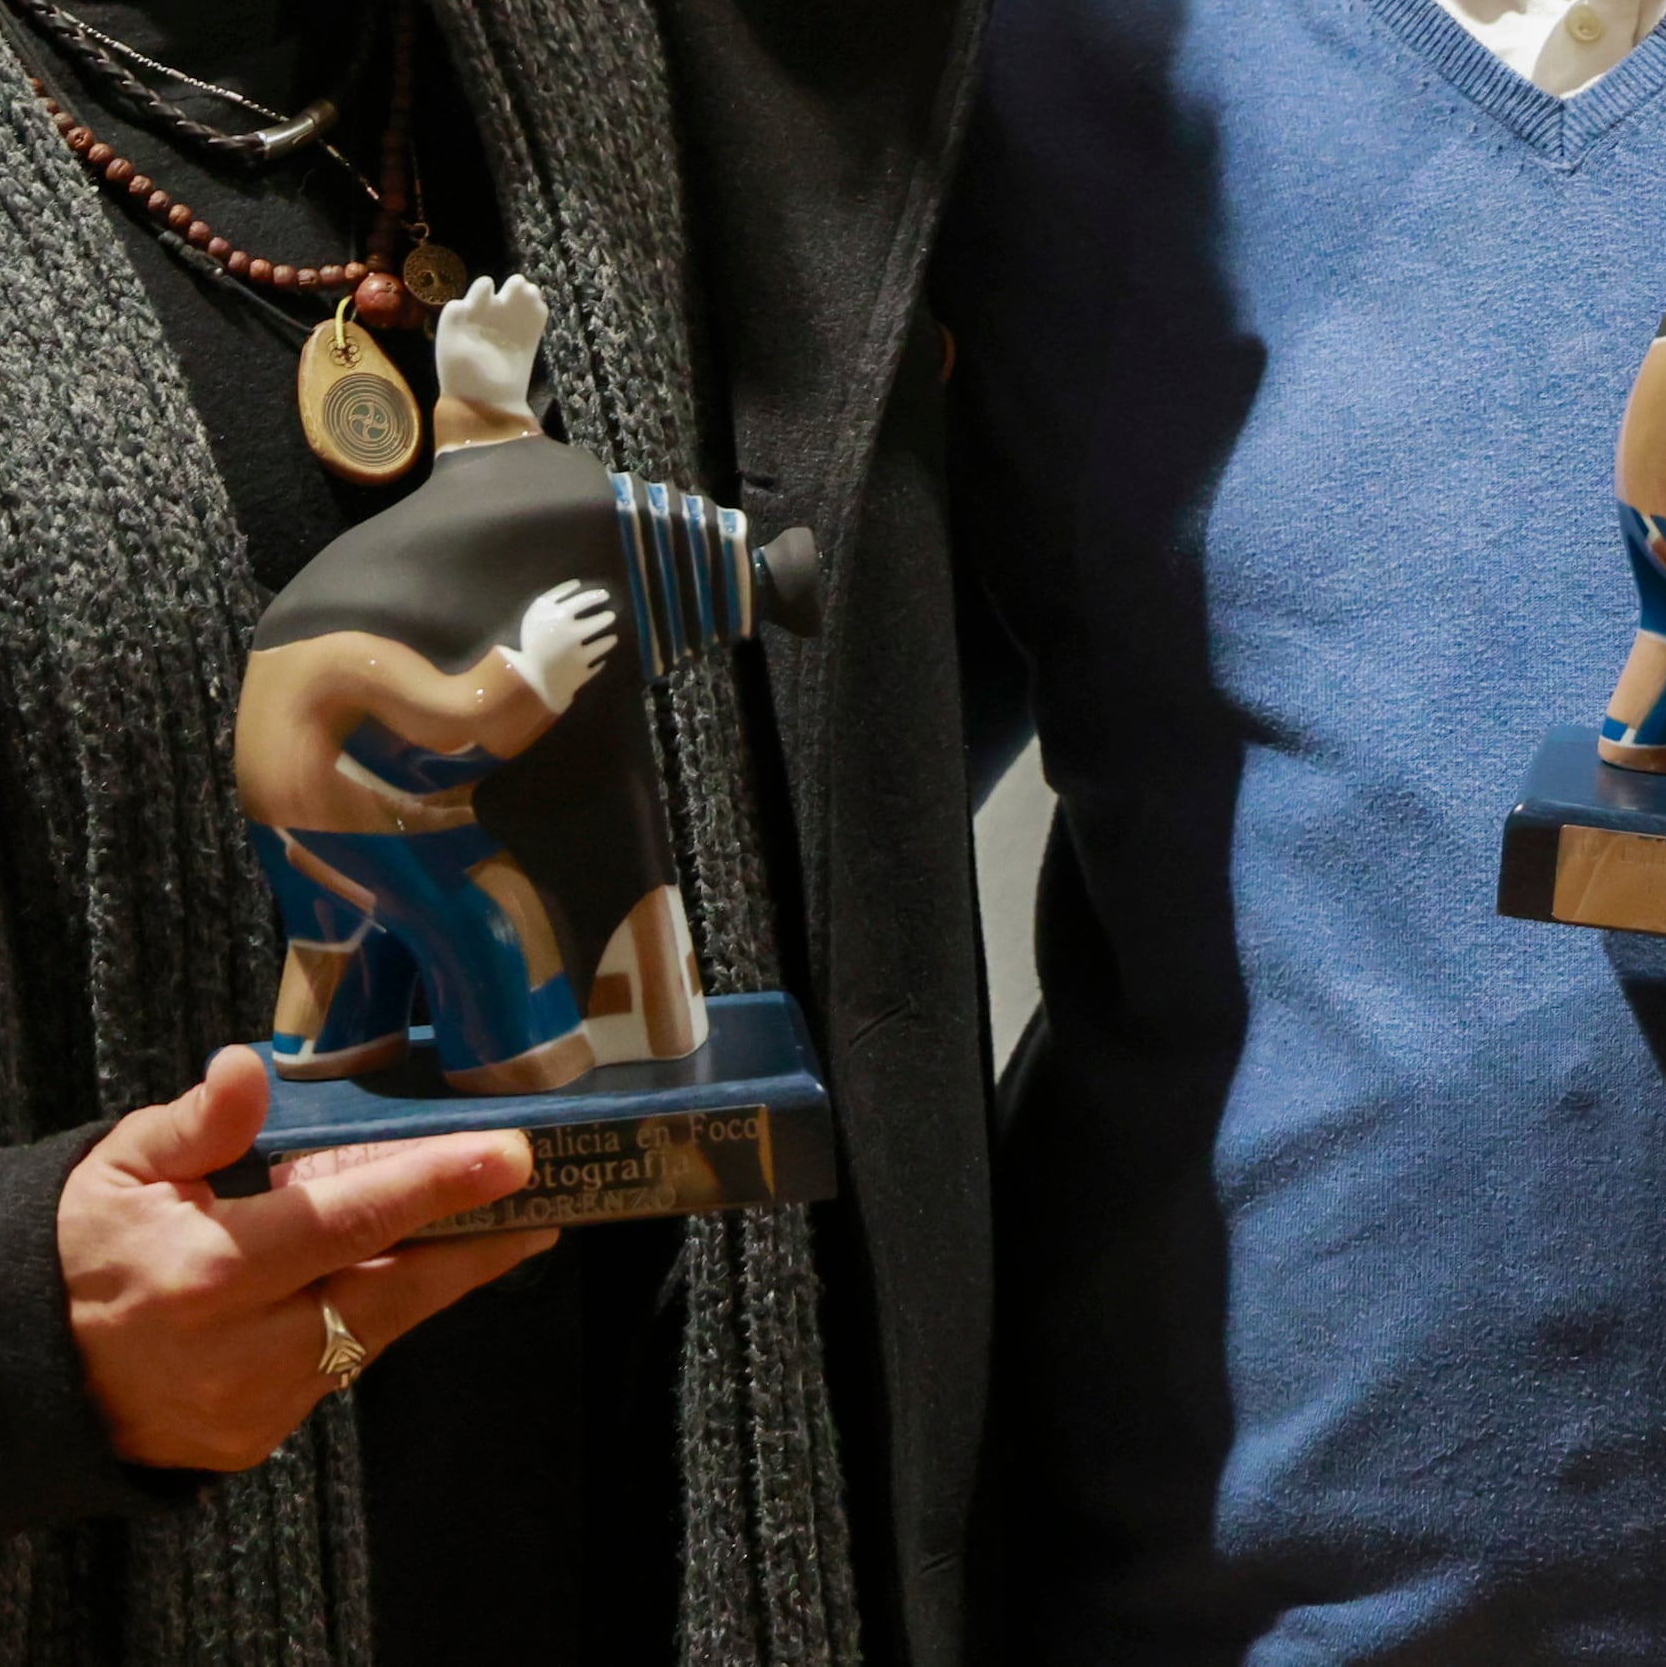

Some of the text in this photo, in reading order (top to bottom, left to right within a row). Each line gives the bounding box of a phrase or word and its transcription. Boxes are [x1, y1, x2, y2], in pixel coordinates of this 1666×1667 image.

[526, 1112, 759, 1160] alicia en Foco
[503, 1184, 678, 1221] LORENZO
